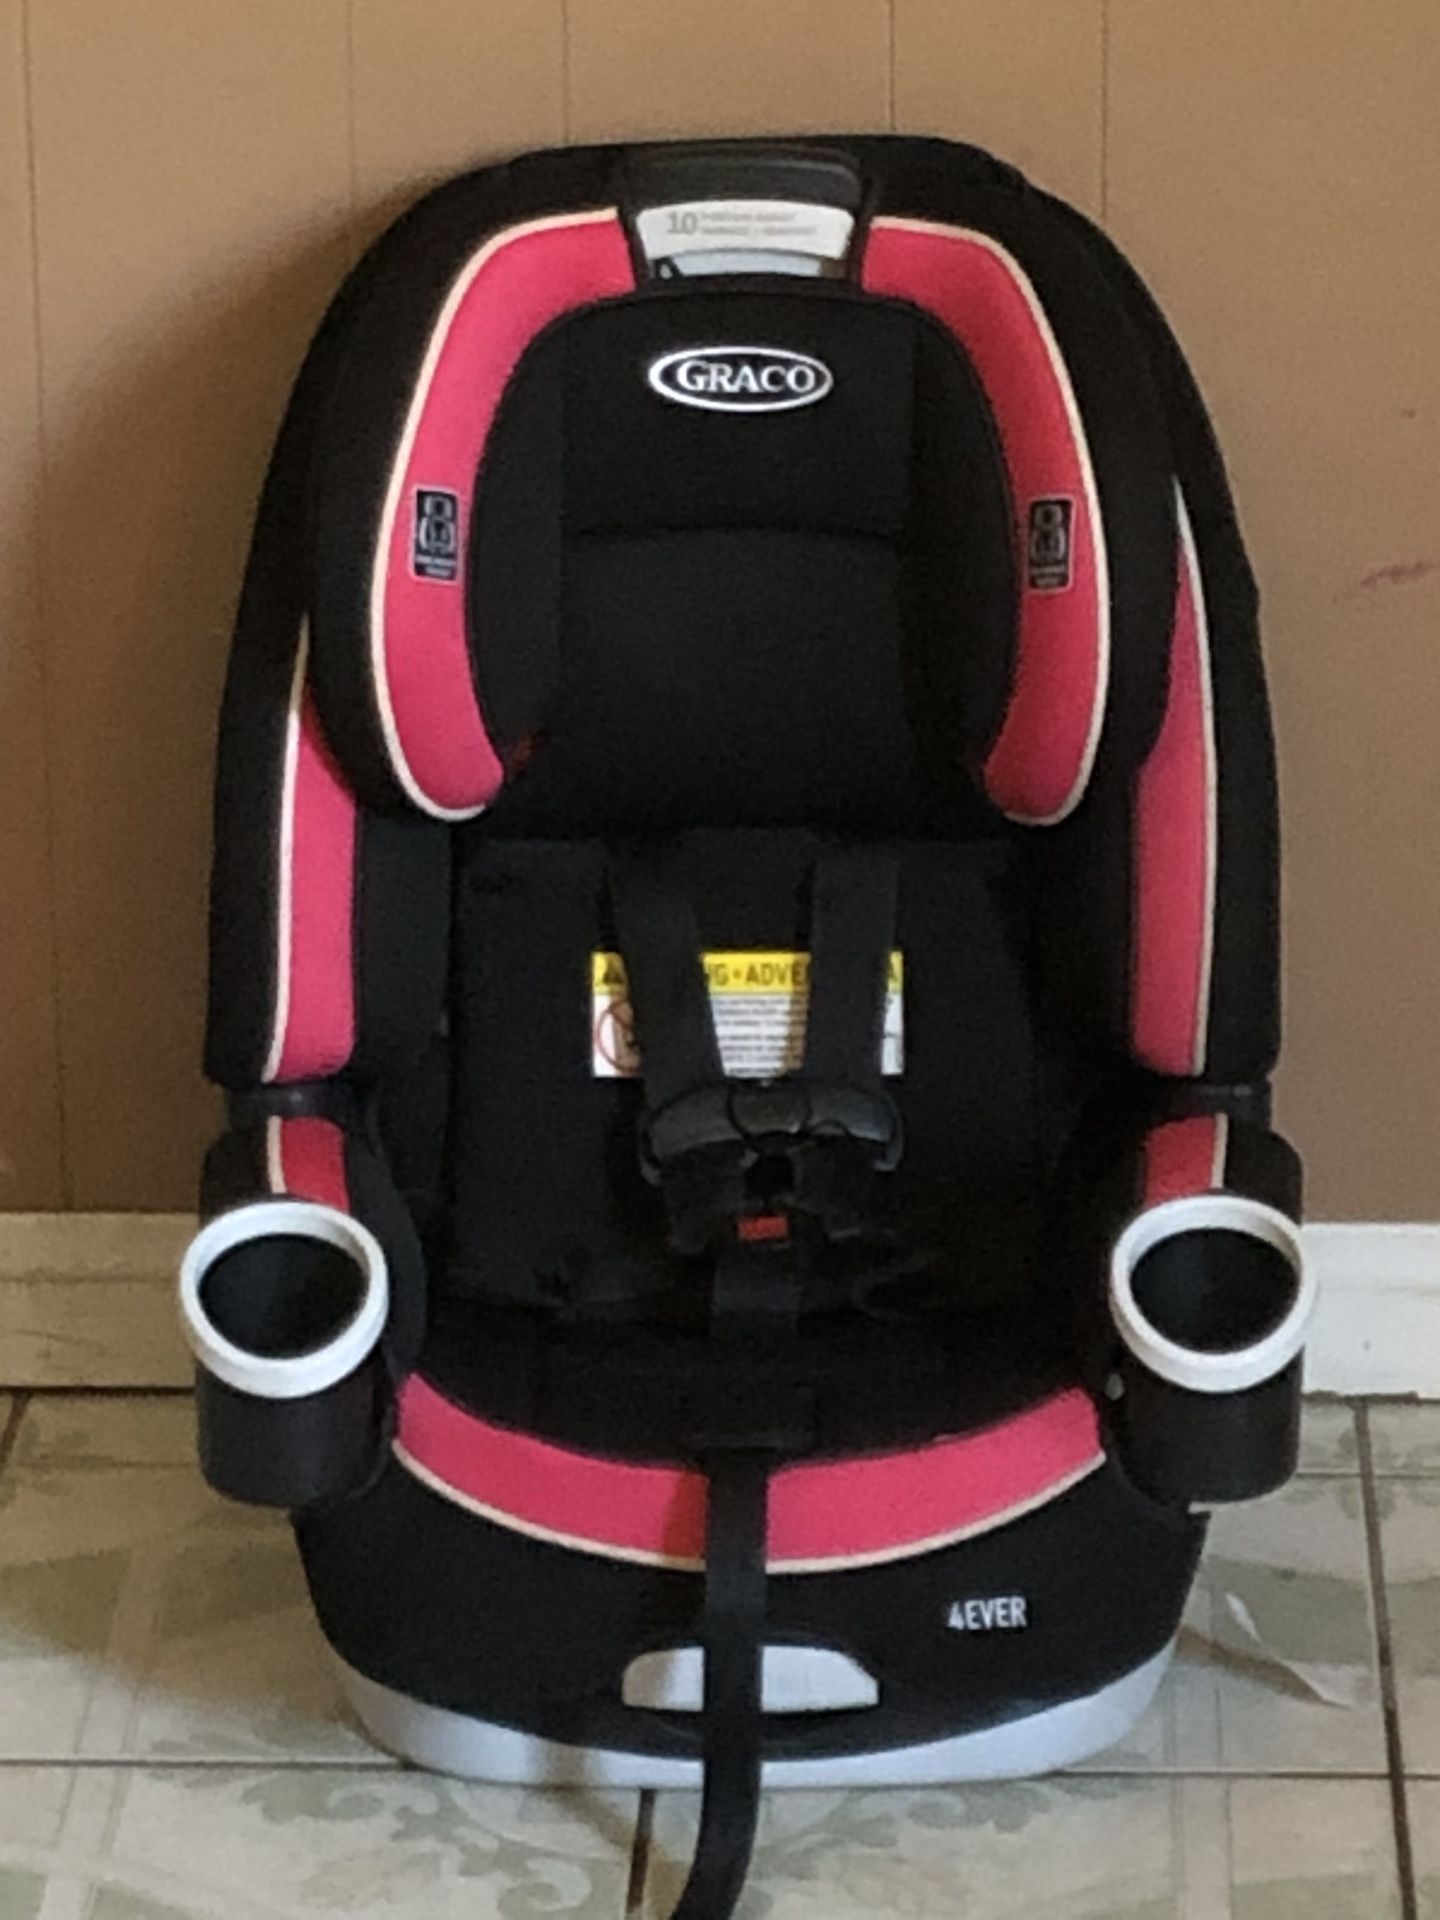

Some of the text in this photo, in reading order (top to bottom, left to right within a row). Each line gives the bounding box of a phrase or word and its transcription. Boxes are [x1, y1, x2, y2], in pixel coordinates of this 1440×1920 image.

[667, 211, 698, 235] 10
[676, 360, 816, 393] GRACO
[746, 962, 809, 986] ADVE
[947, 1596, 1028, 1630] 4EVER
